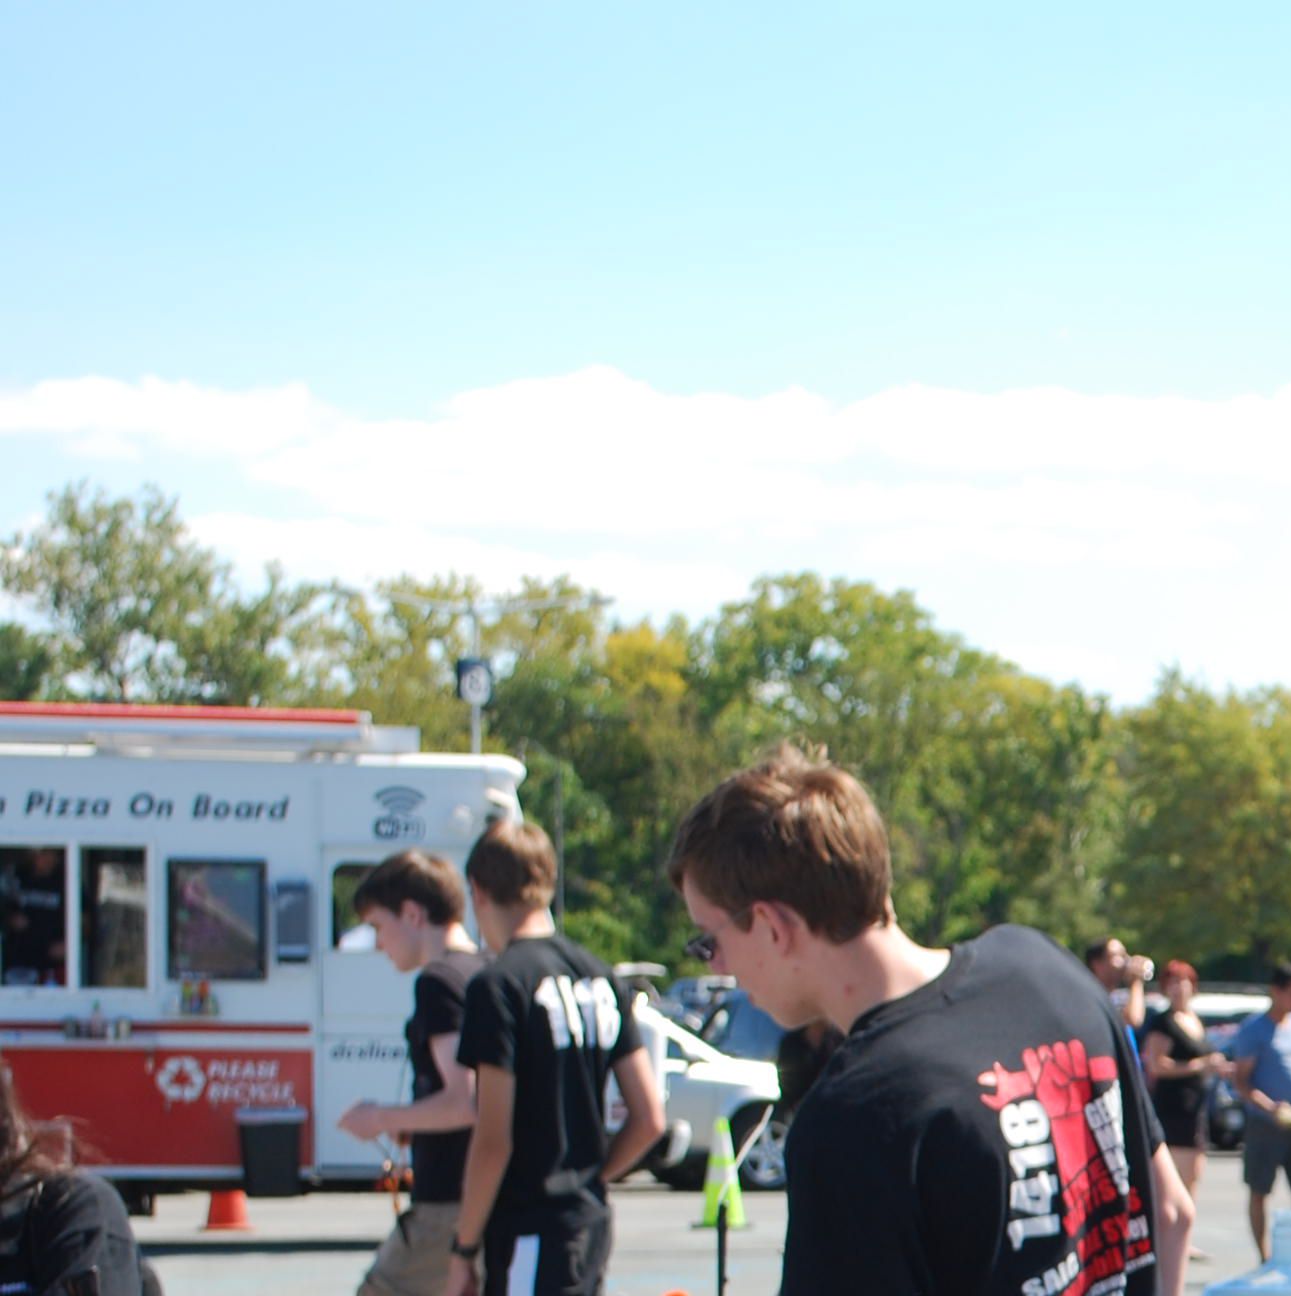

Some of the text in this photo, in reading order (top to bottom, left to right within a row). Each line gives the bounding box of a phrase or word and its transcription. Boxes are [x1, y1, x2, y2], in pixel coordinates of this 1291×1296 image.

[26, 790, 111, 817] Pizza
[129, 793, 174, 818] On
[193, 793, 290, 820] Board
[208, 1060, 280, 1080] PLEASE
[208, 1081, 296, 1102] RECYCLE
[1000, 1099, 1060, 1251] 1418
